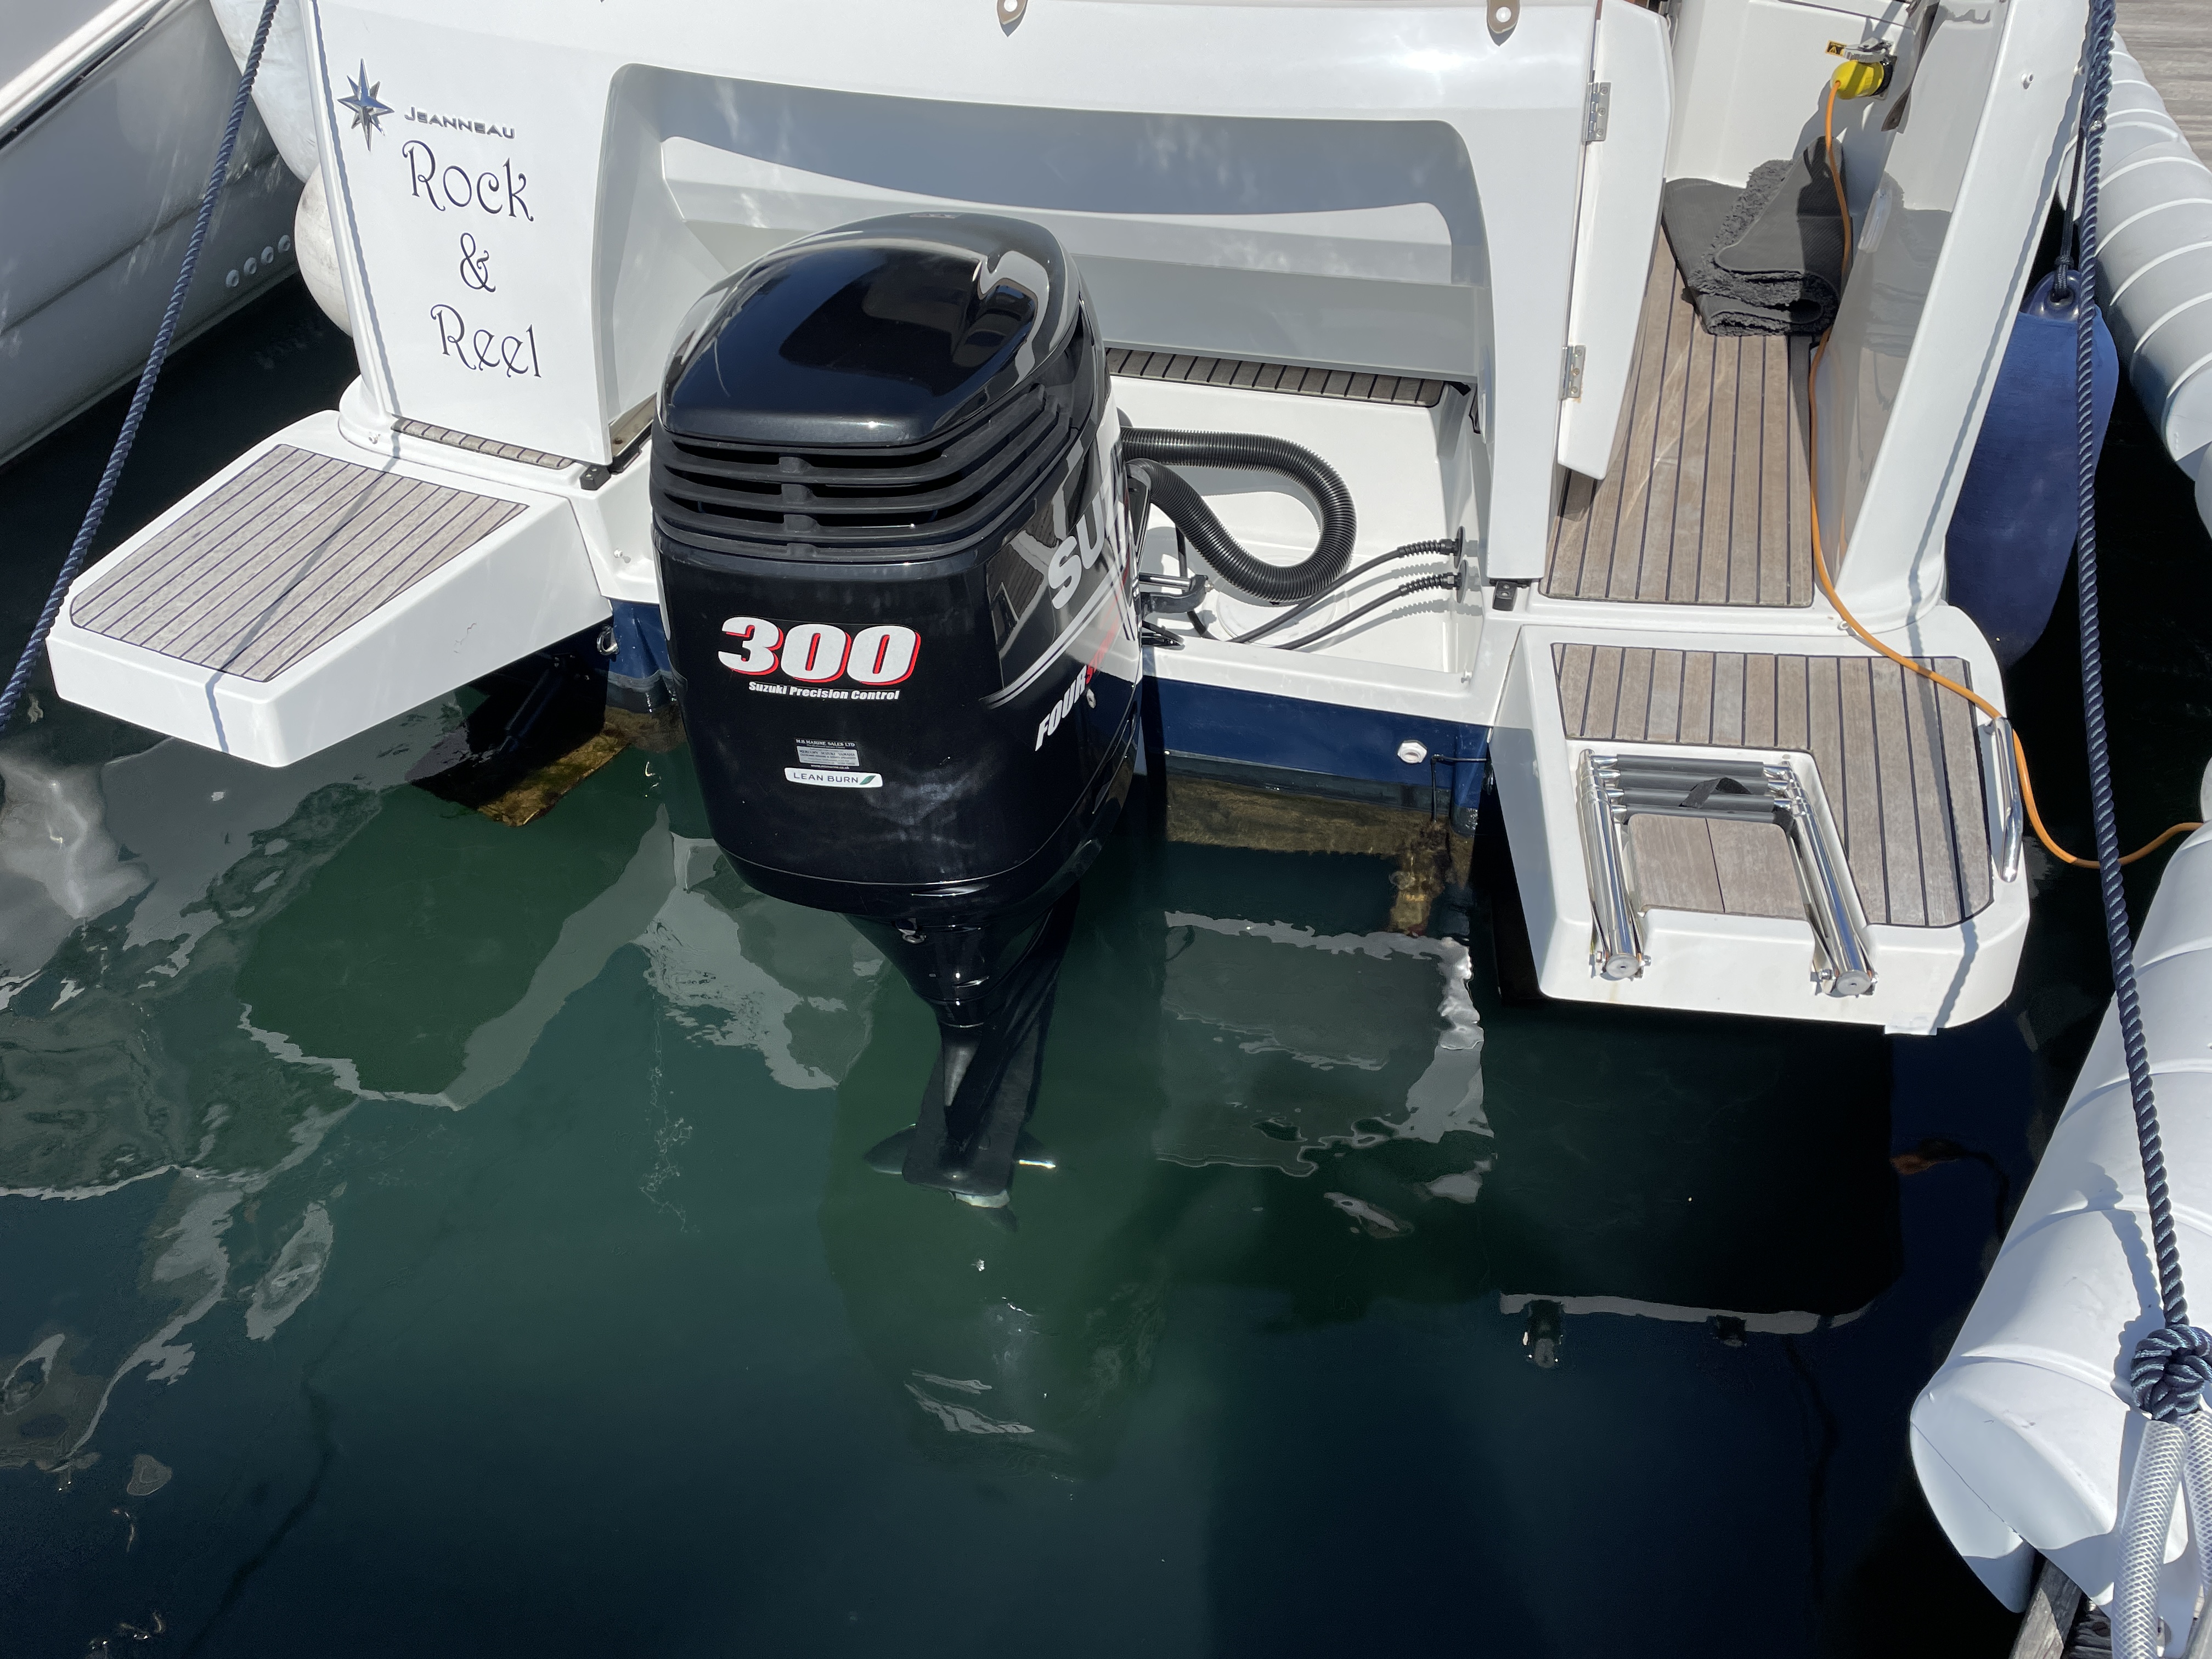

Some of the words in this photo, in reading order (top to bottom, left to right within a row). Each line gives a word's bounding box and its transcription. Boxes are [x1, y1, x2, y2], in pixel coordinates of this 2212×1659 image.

[404, 106, 515, 140] JEANNEAU
[402, 140, 534, 222] Rock
[460, 233, 496, 292] &
[430, 303, 541, 378] Reel
[718, 616, 921, 685] 300
[748, 681, 787, 695] Suzuki
[789, 686, 848, 700] Precision
[851, 690, 900, 701] Control
[794, 772, 823, 781] LEAN
